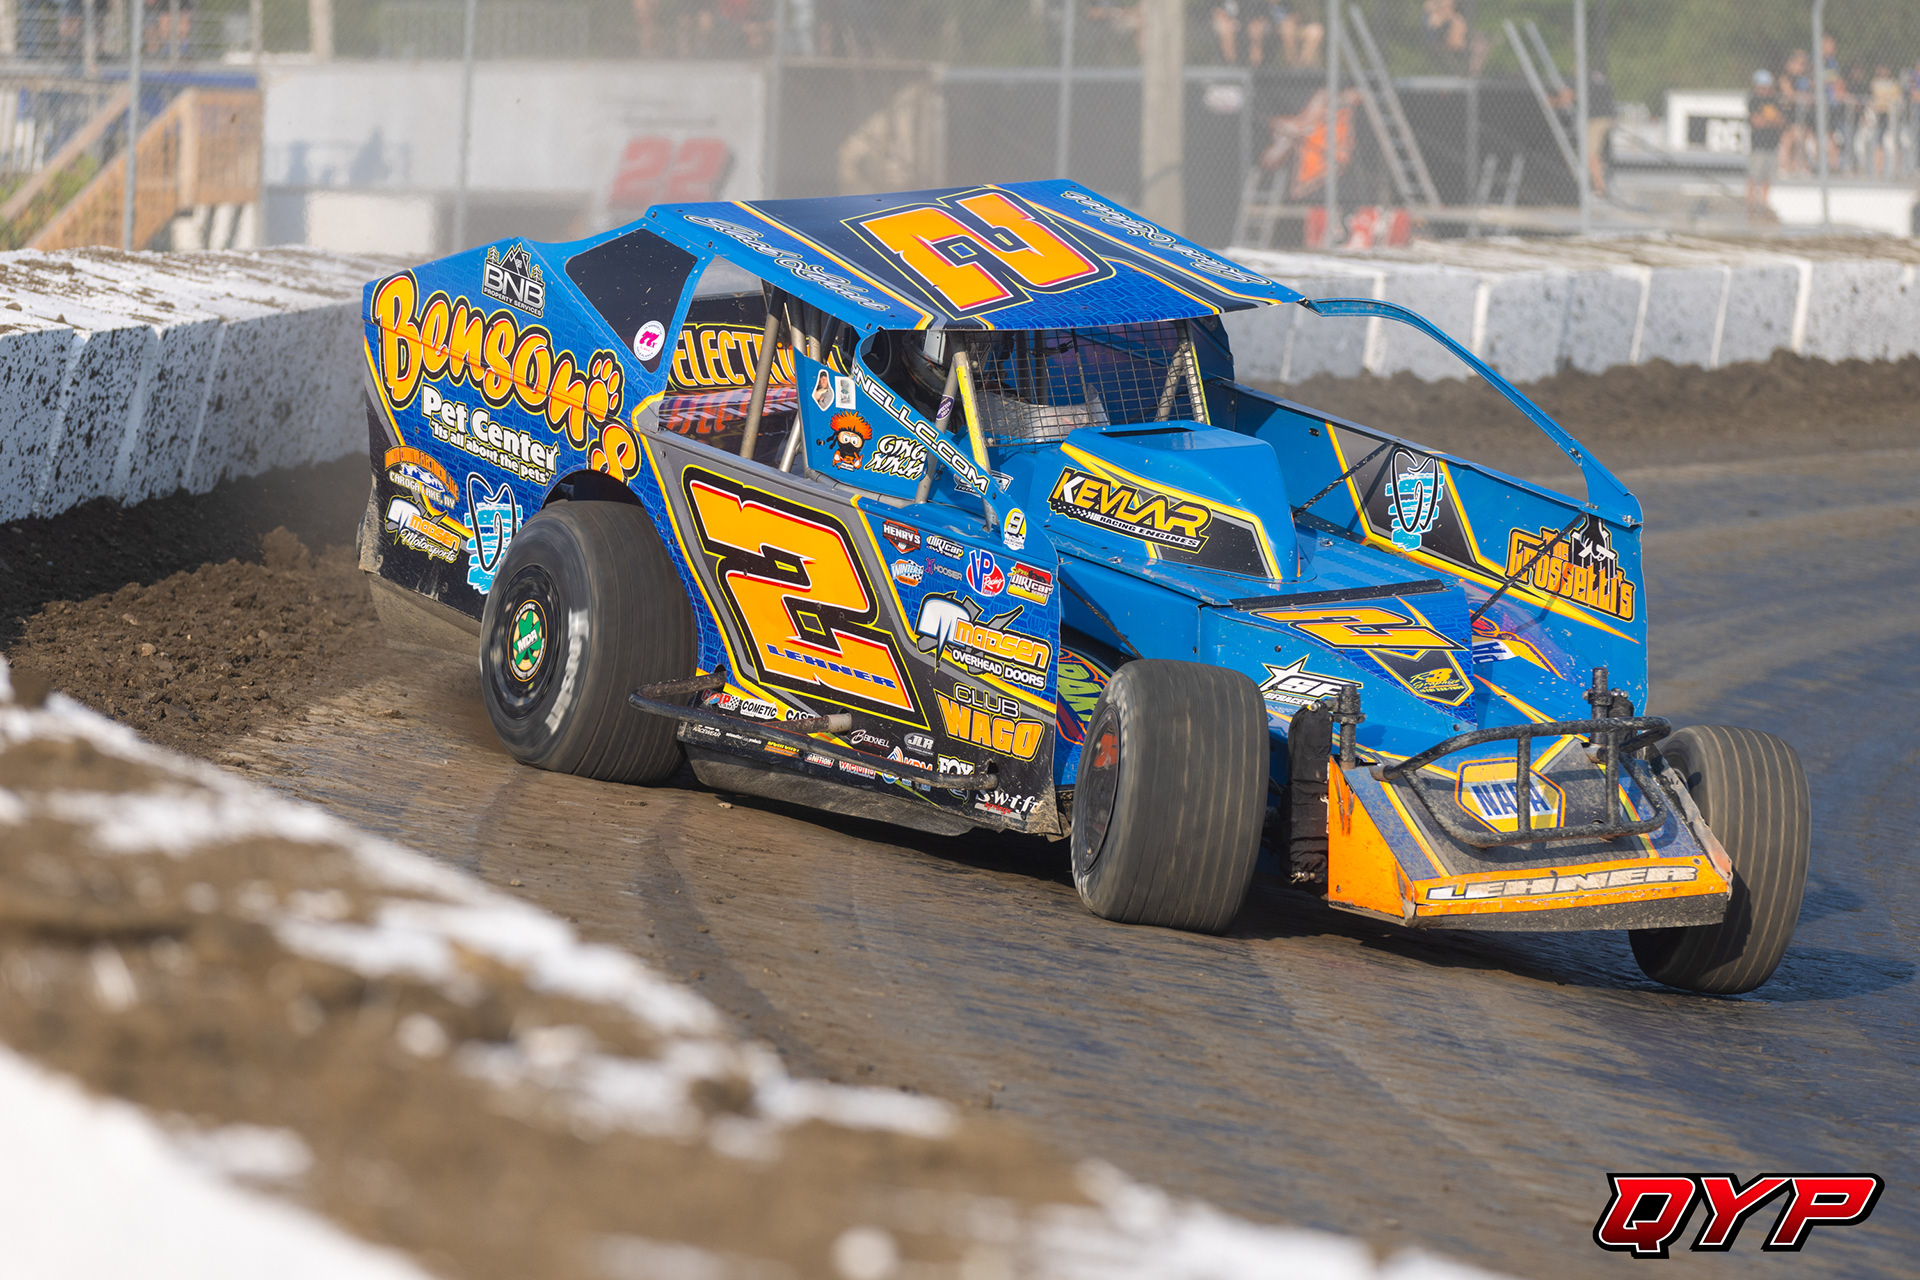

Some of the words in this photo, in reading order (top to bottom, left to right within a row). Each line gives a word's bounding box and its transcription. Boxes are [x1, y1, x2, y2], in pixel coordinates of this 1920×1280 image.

[607, 136, 726, 210] 22
[861, 193, 1098, 311] 2
[484, 287, 513, 304] PROPERTY
[514, 300, 542, 317] SERVICES
[485, 263, 544, 309] BNB
[422, 384, 467, 434] Pet
[472, 408, 560, 474] Center
[450, 432, 465, 450] all
[466, 438, 499, 465] about
[500, 453, 519, 475] the
[389, 471, 420, 493] CAROGA
[443, 493, 456, 509] NY
[1053, 472, 1213, 538] KEVLAR
[1007, 511, 1024, 535] 9
[1099, 516, 1137, 534] RACING
[1138, 527, 1199, 547] ENGINES
[401, 528, 456, 561] Motorsports
[891, 562, 924, 580] WINTERS
[933, 563, 963, 582] HOOSIER
[969, 549, 995, 594] VP
[984, 576, 1003, 590] Racing
[1011, 574, 1054, 595] DIRTcar
[690, 479, 915, 713] 2
[1257, 608, 1454, 648] 2
[766, 643, 897, 690] LEHNER
[952, 649, 1003, 676] OVERHEAD
[1004, 667, 1045, 688] DOORS
[742, 700, 778, 718] COMETIC
[955, 684, 1020, 718] CLUB
[908, 734, 934, 750] JLR
[937, 693, 1044, 759] WAGO
[984, 802, 1013, 815] springs
[1426, 865, 1700, 900] LEHNER
